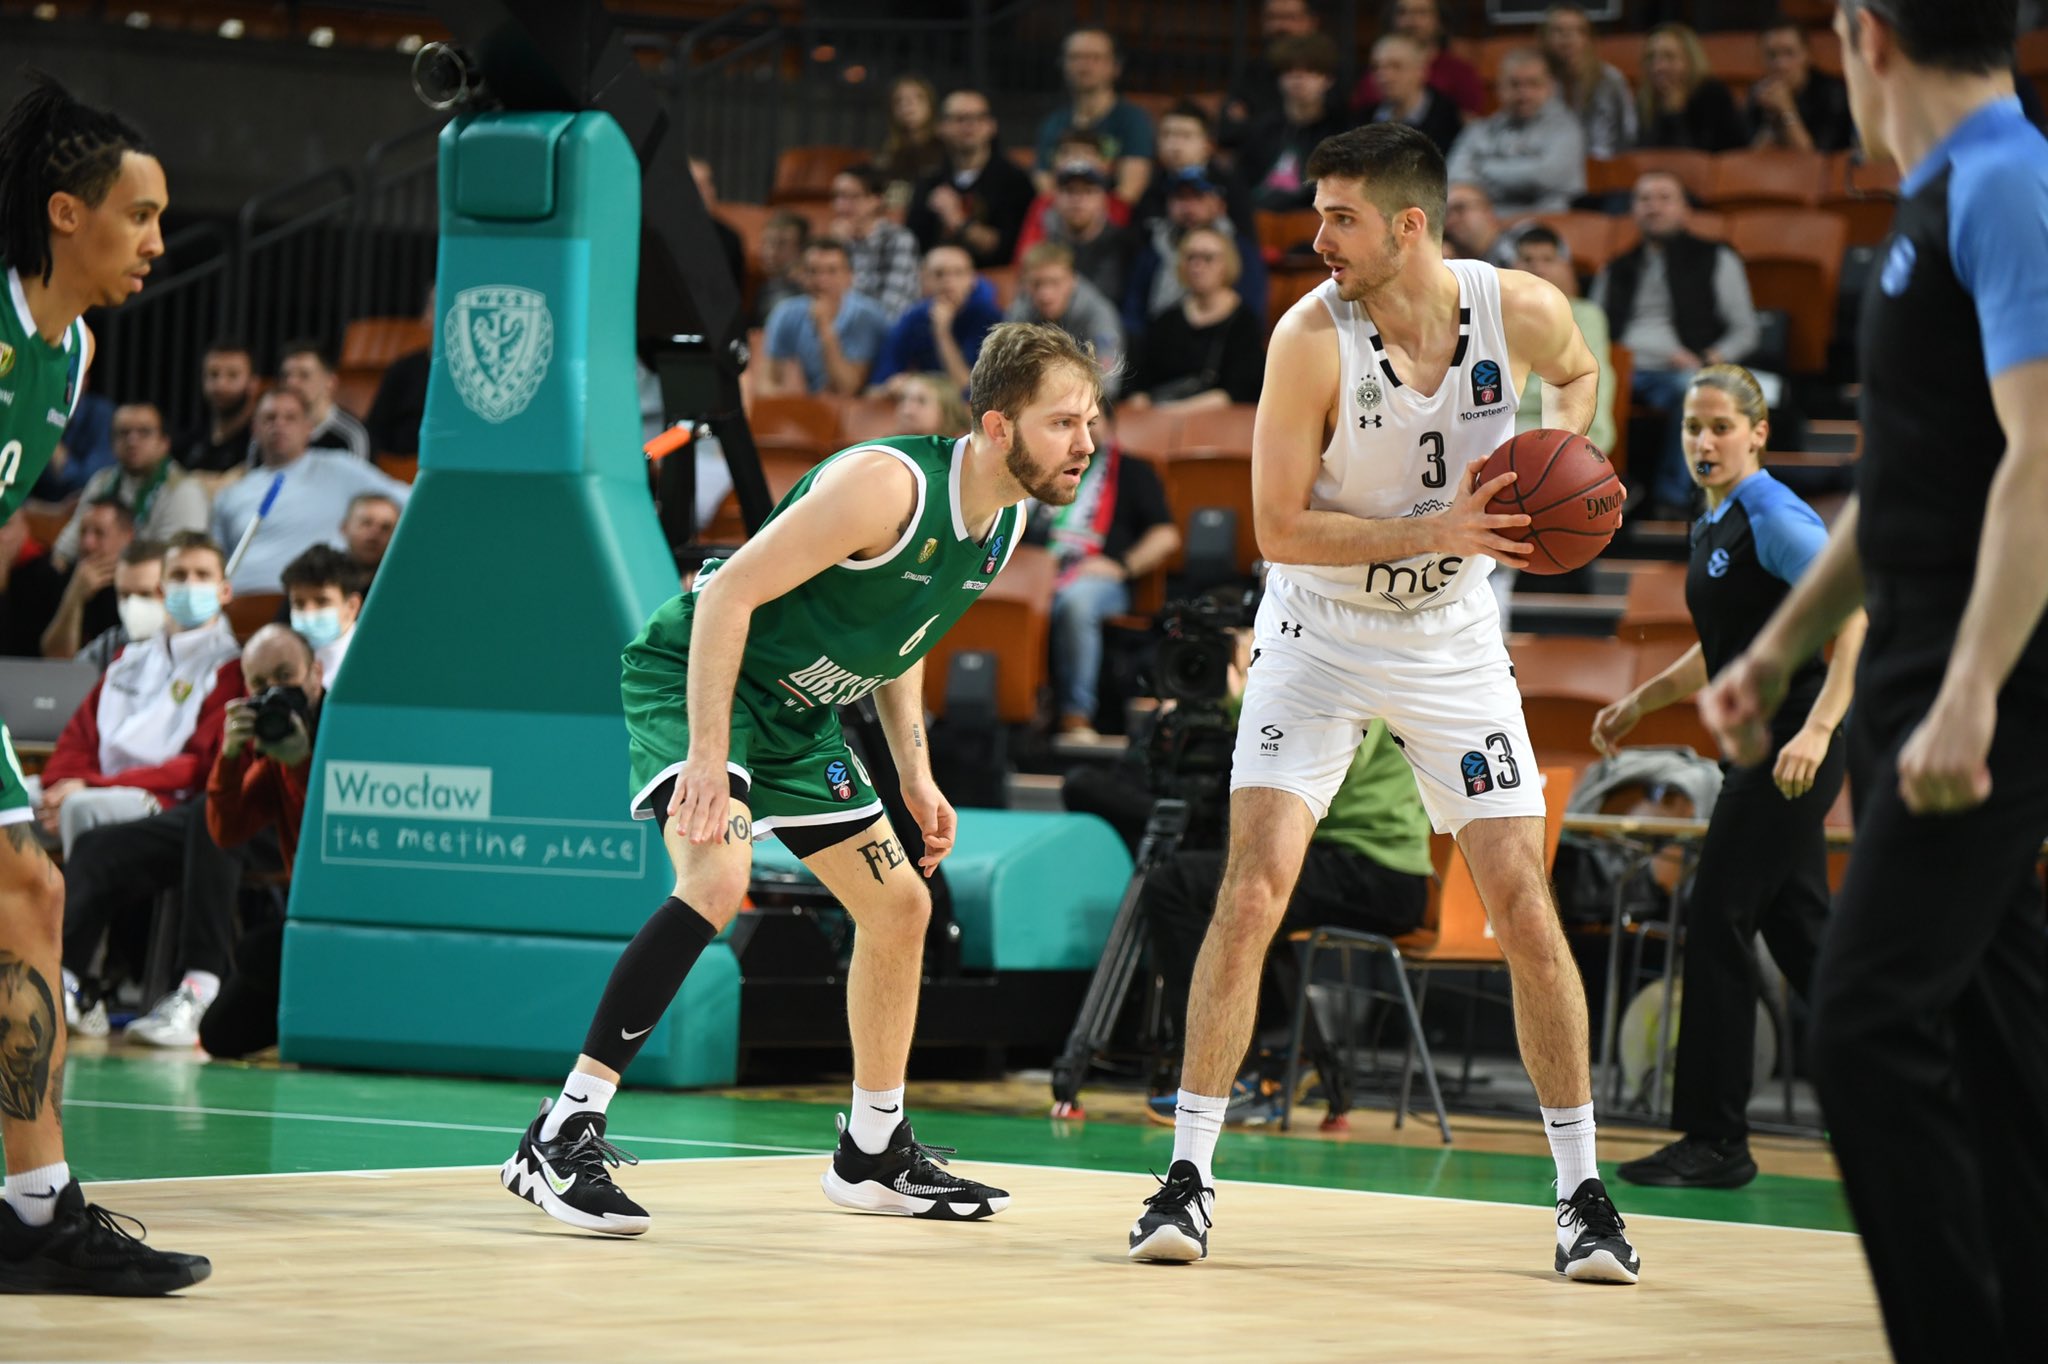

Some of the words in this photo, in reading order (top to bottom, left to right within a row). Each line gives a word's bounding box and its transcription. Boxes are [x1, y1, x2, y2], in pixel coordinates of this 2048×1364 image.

[1419, 431, 1447, 489] 3
[1365, 556, 1463, 593] mts
[899, 613, 940, 657] 6
[1260, 742, 1279, 751] NIS
[1485, 732, 1521, 790] 3
[334, 769, 482, 811] Wrocław
